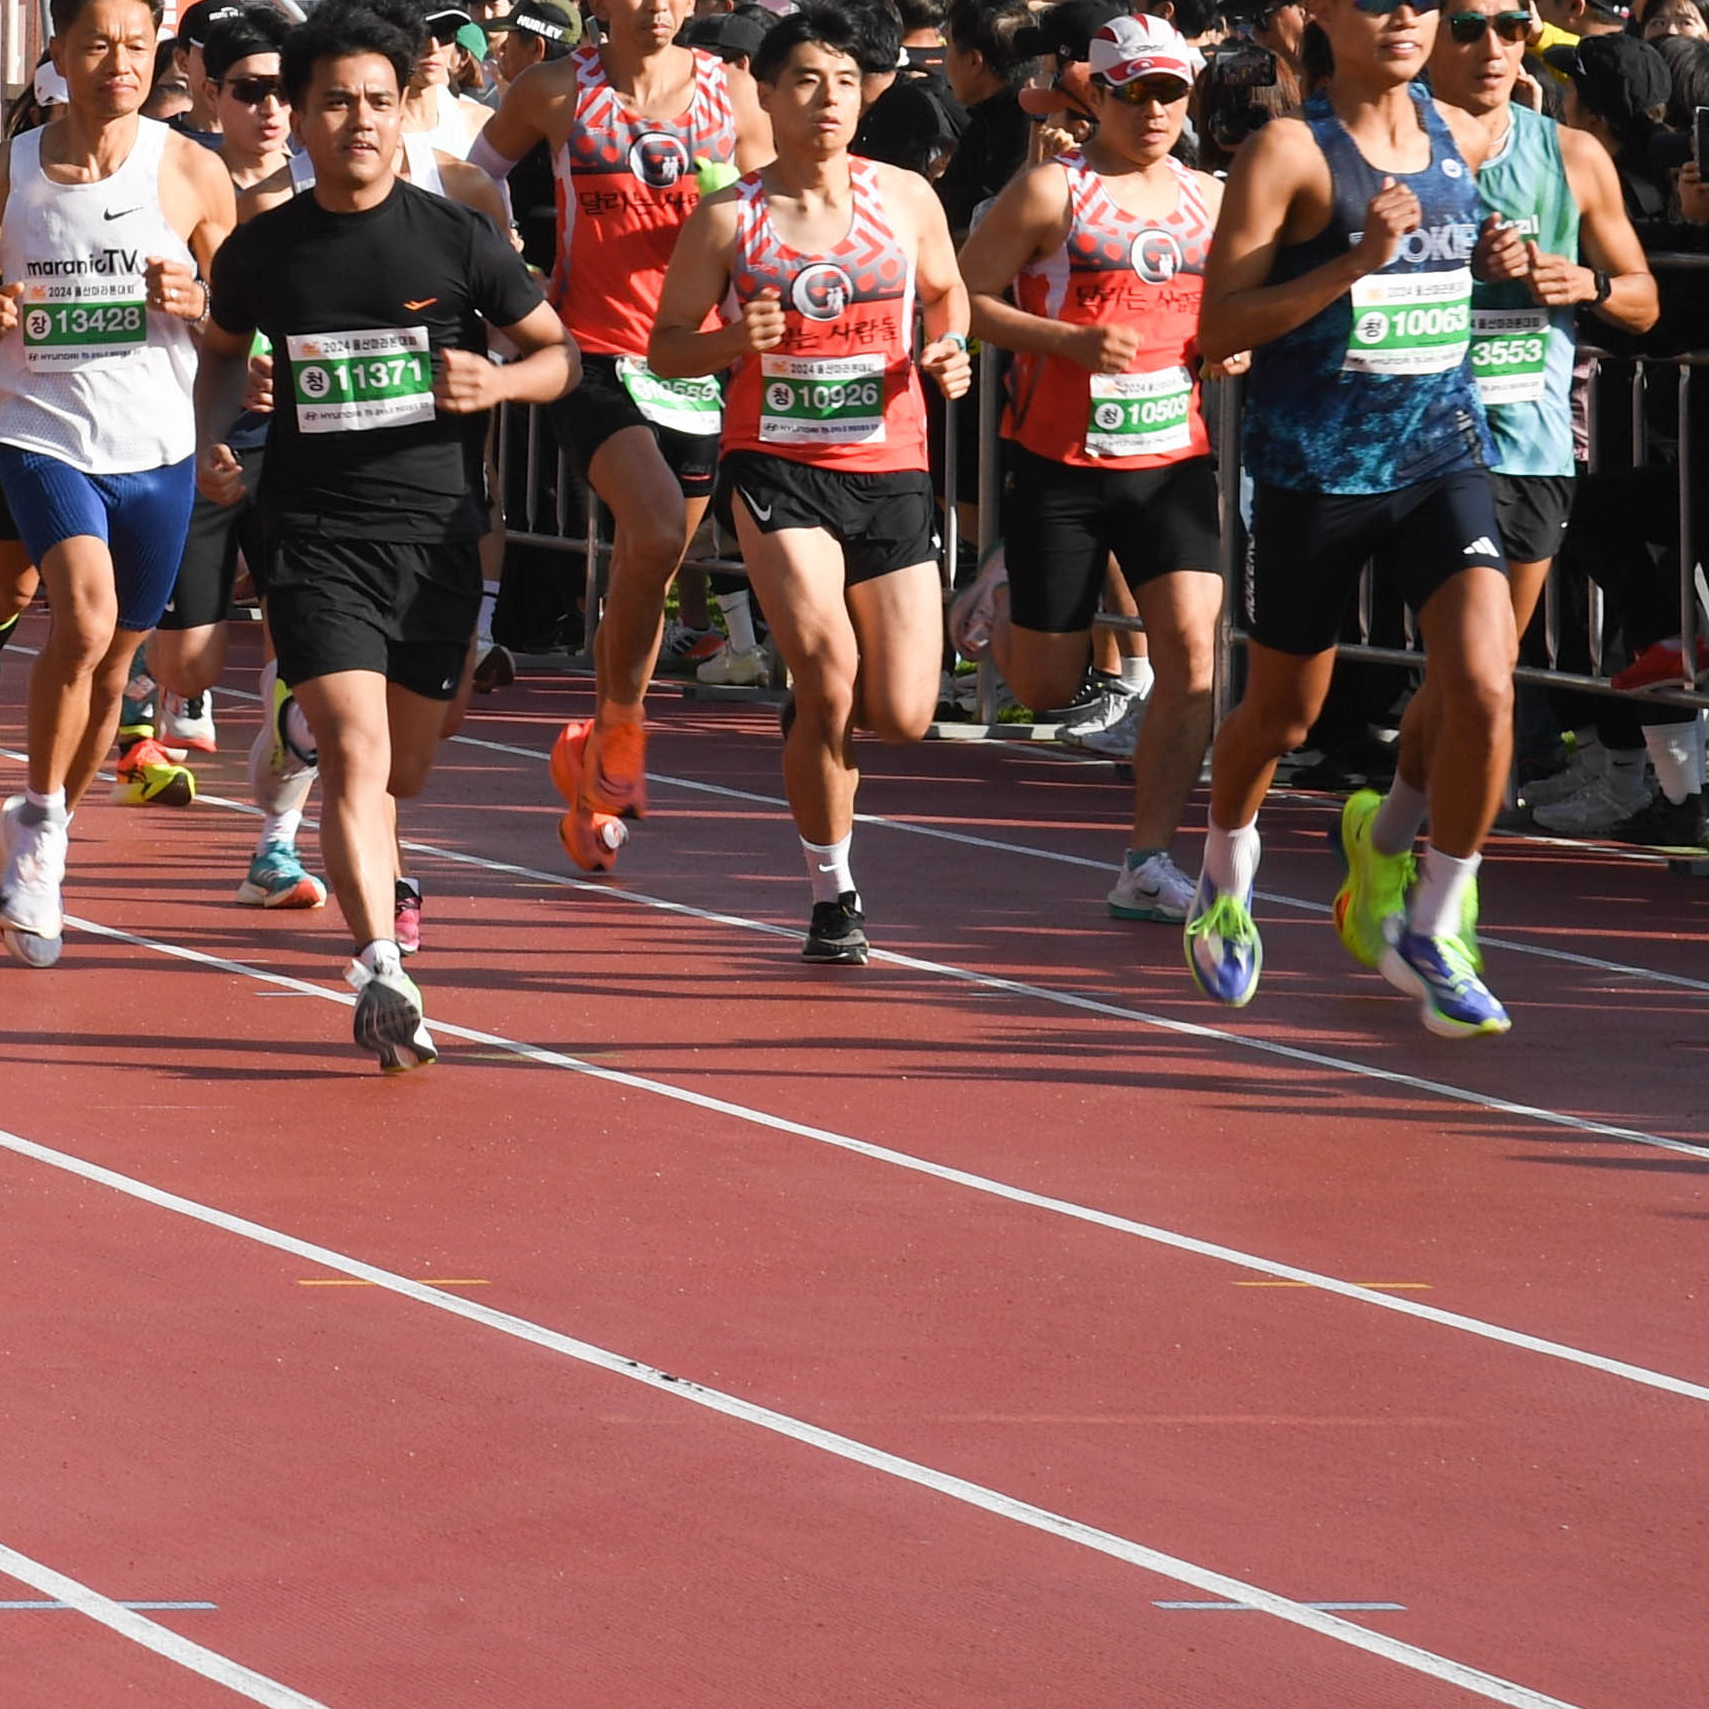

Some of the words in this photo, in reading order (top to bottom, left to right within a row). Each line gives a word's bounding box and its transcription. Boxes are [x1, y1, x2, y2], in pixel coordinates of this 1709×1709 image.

[517, 14, 563, 40] HURLEY
[27, 249, 138, 277] maranicTV
[49, 287, 72, 298] 2024
[56, 307, 141, 333] 13428
[1392, 305, 1469, 337] 10063
[323, 340, 350, 353] 2024
[1472, 339, 1543, 366] 3553
[334, 357, 422, 391] 11371
[799, 382, 878, 409] 10926
